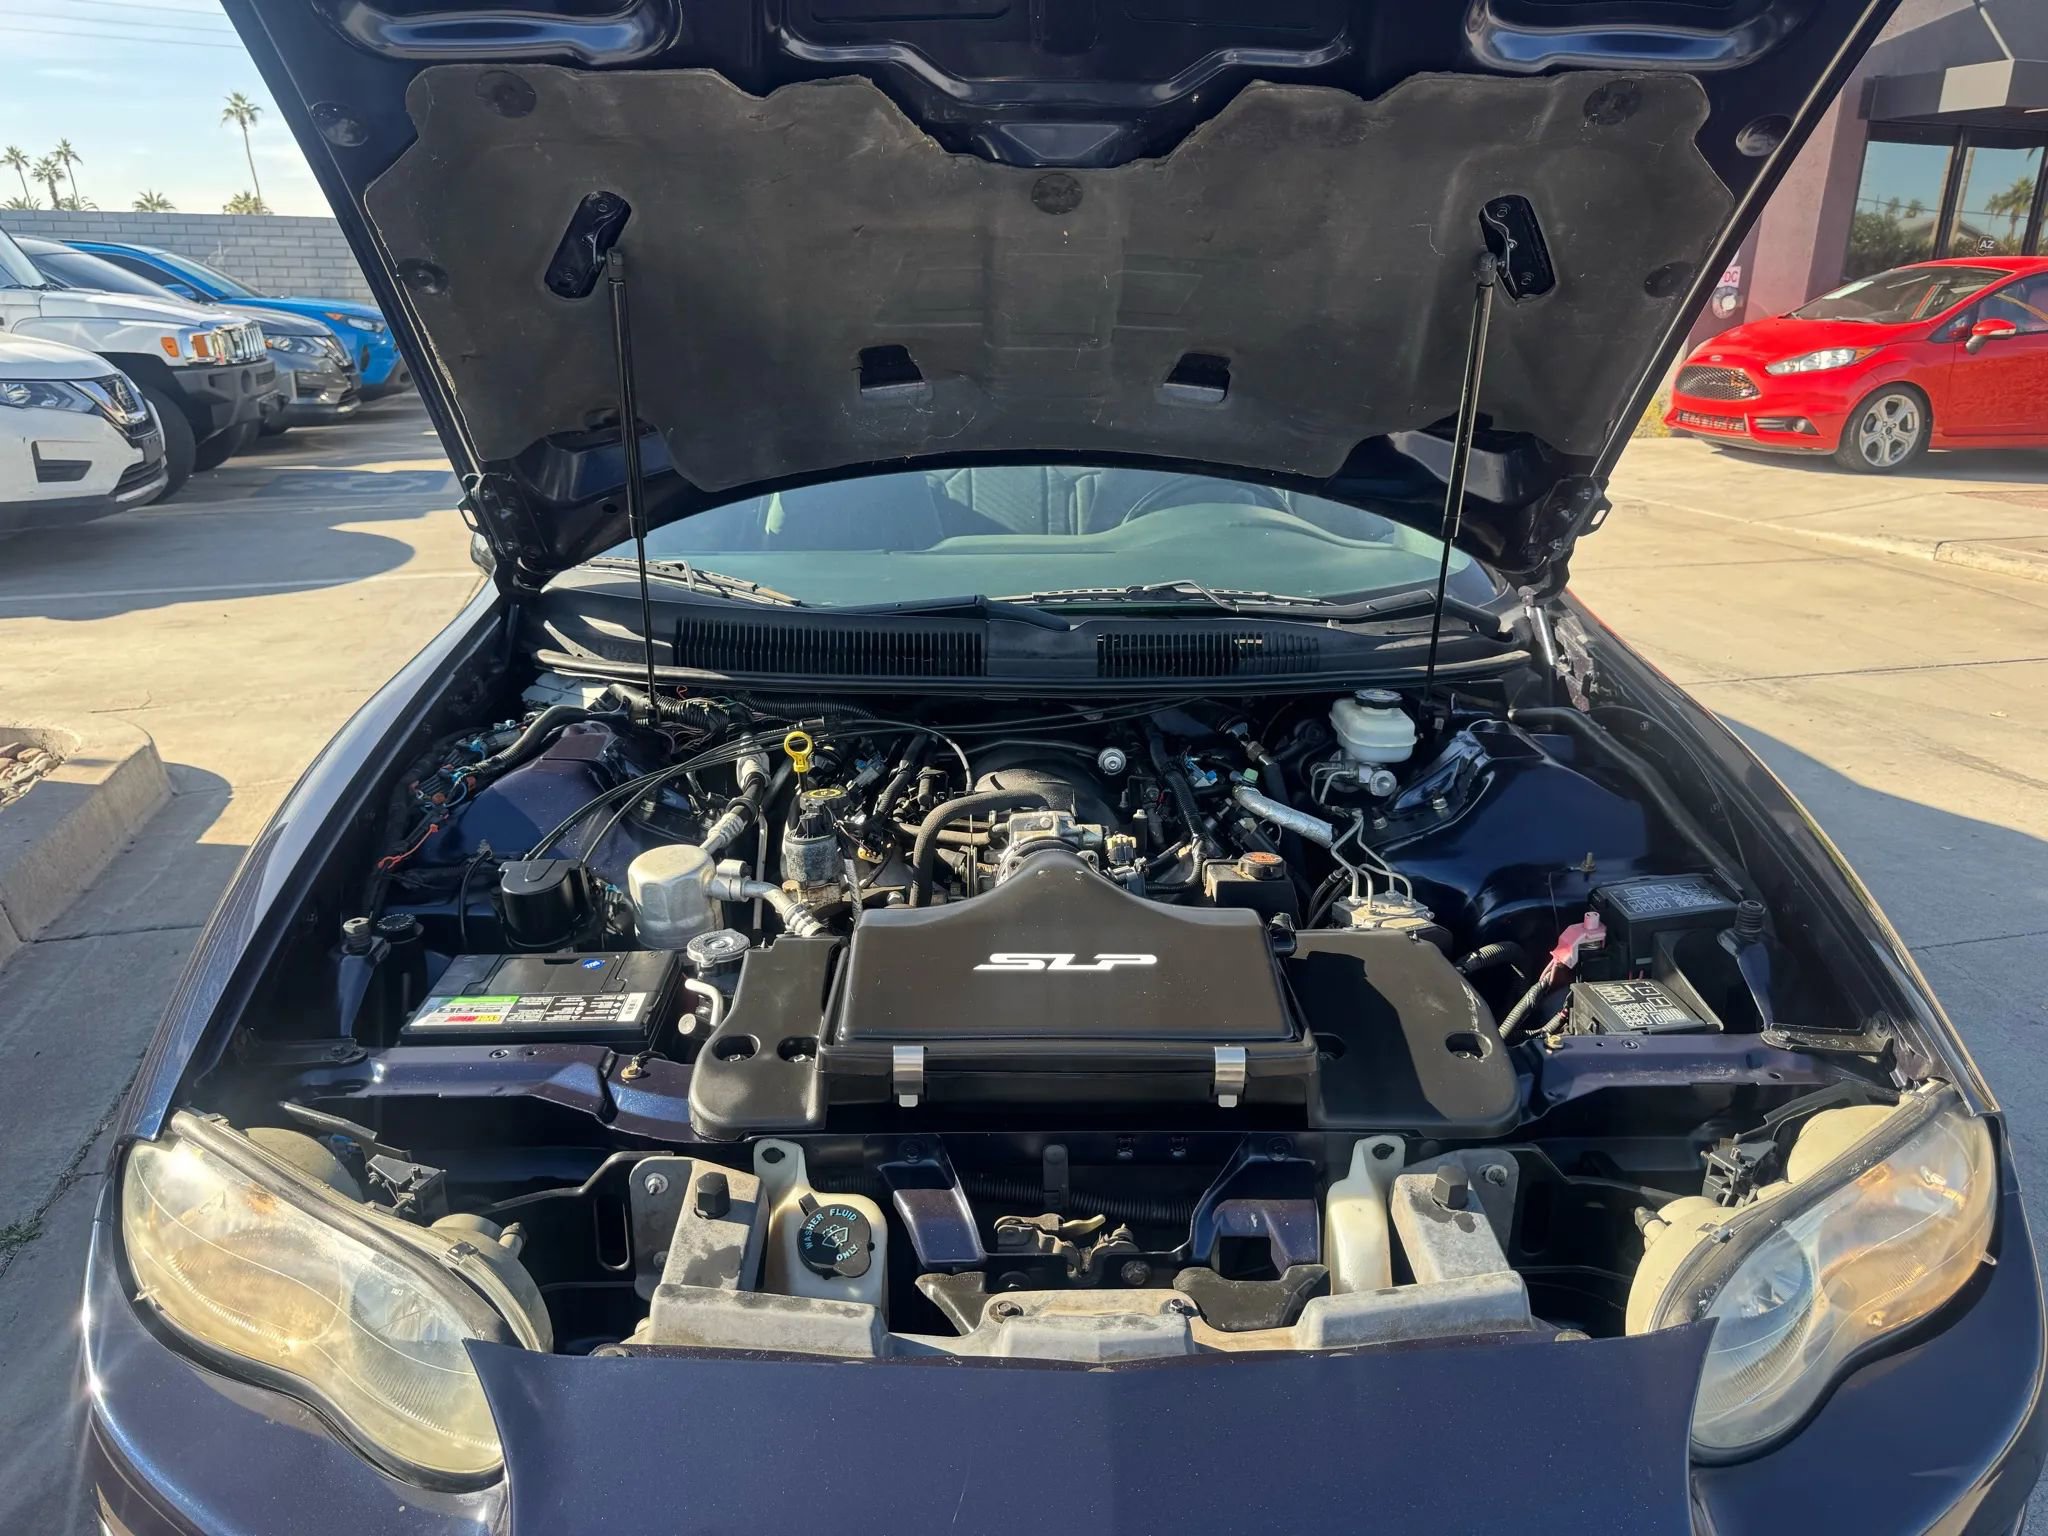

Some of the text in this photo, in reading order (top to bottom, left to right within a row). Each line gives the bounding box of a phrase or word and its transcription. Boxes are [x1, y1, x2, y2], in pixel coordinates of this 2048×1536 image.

[1979, 240, 1995, 249] AZ
[973, 953, 1158, 971] SLP
[804, 1208, 857, 1249] WASHER FLUID
[836, 1244, 858, 1261] ONLY
